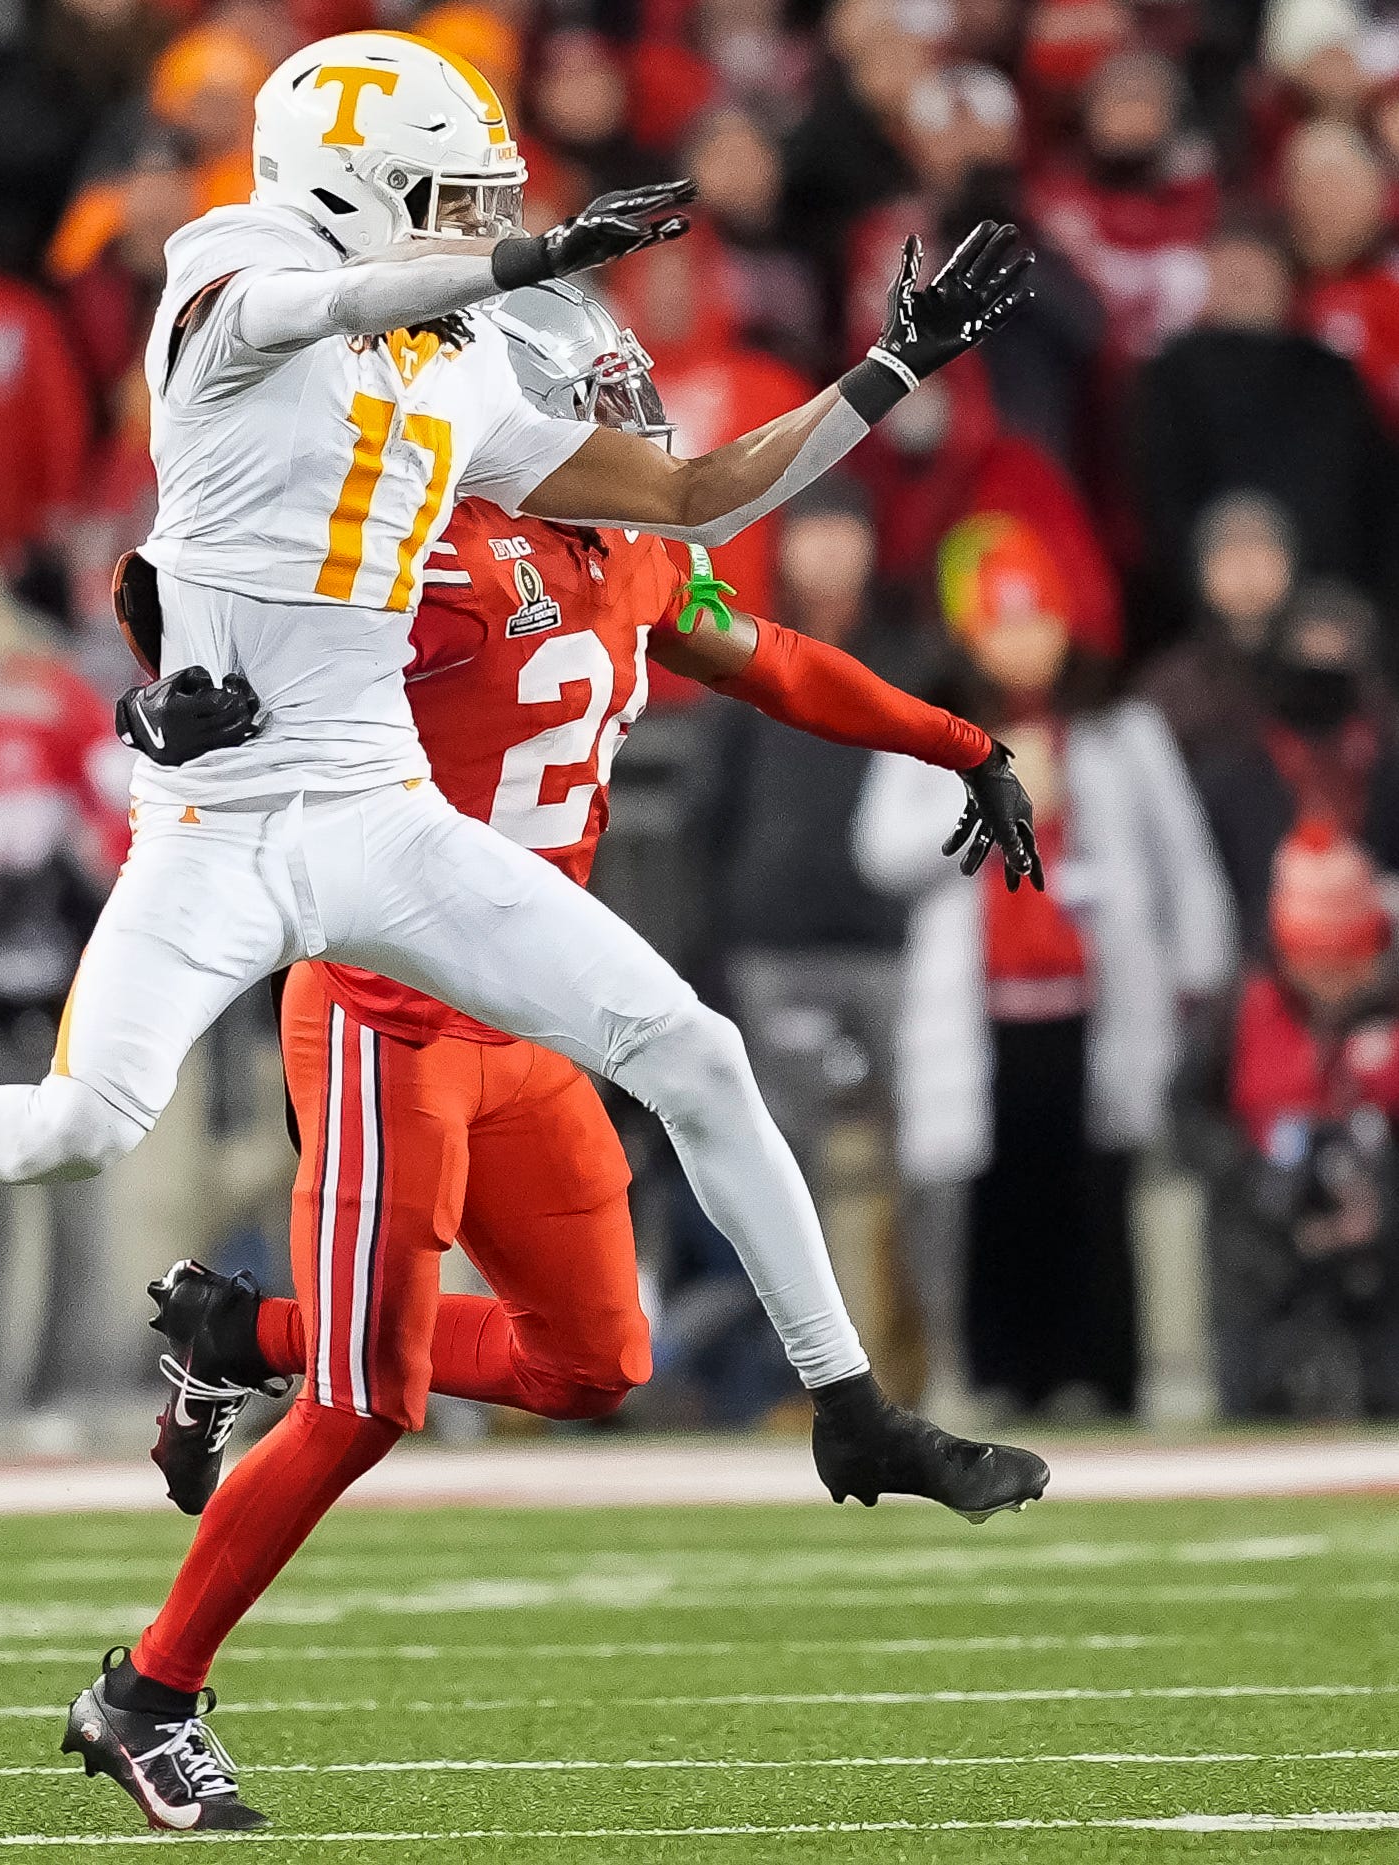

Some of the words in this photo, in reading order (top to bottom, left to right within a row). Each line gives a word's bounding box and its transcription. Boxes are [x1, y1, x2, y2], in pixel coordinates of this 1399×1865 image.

[313, 66, 400, 146] T
[400, 345, 419, 381] T
[314, 391, 452, 613] 17
